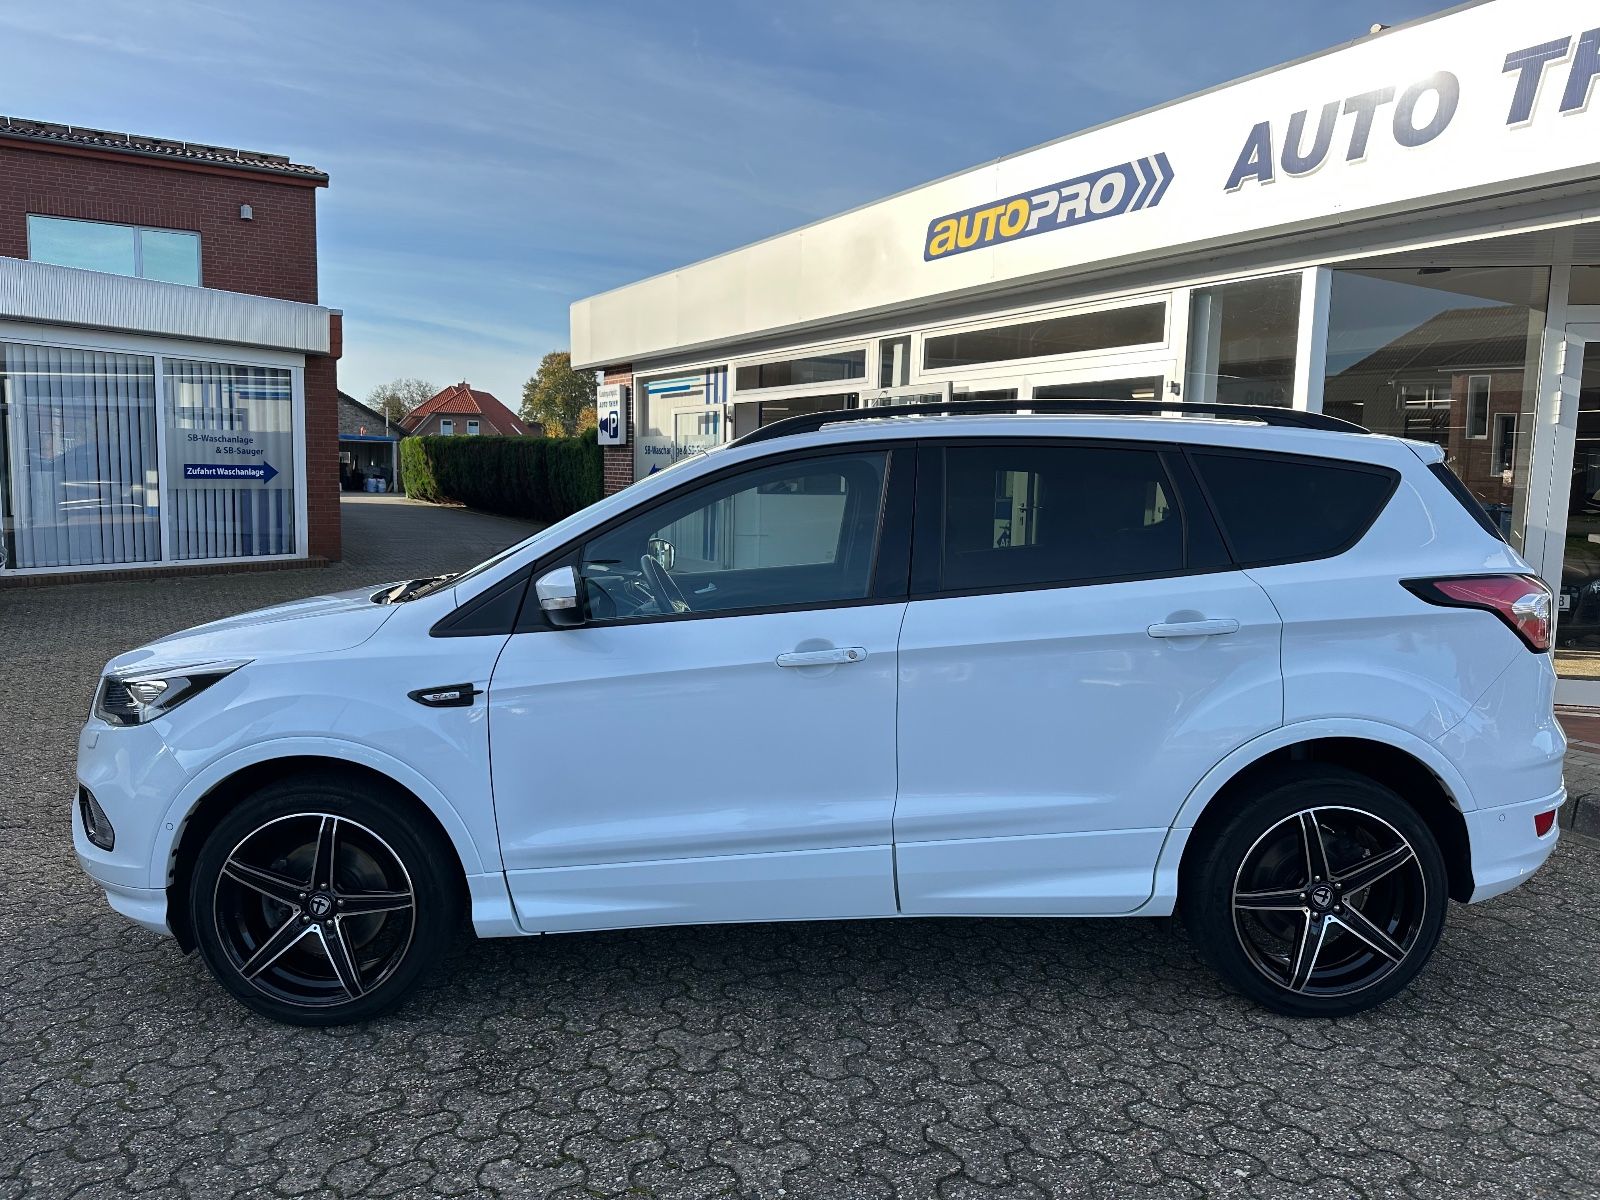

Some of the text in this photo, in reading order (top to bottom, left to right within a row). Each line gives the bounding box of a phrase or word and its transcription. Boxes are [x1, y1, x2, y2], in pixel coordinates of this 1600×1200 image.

[1223, 70, 1460, 192] AUTO
[610, 413, 618, 436] P
[187, 433, 254, 446] SB-Waschanlage
[215, 446, 264, 457] & SB-Sauger
[186, 467, 265, 477] Zufahrt Waschanlage
